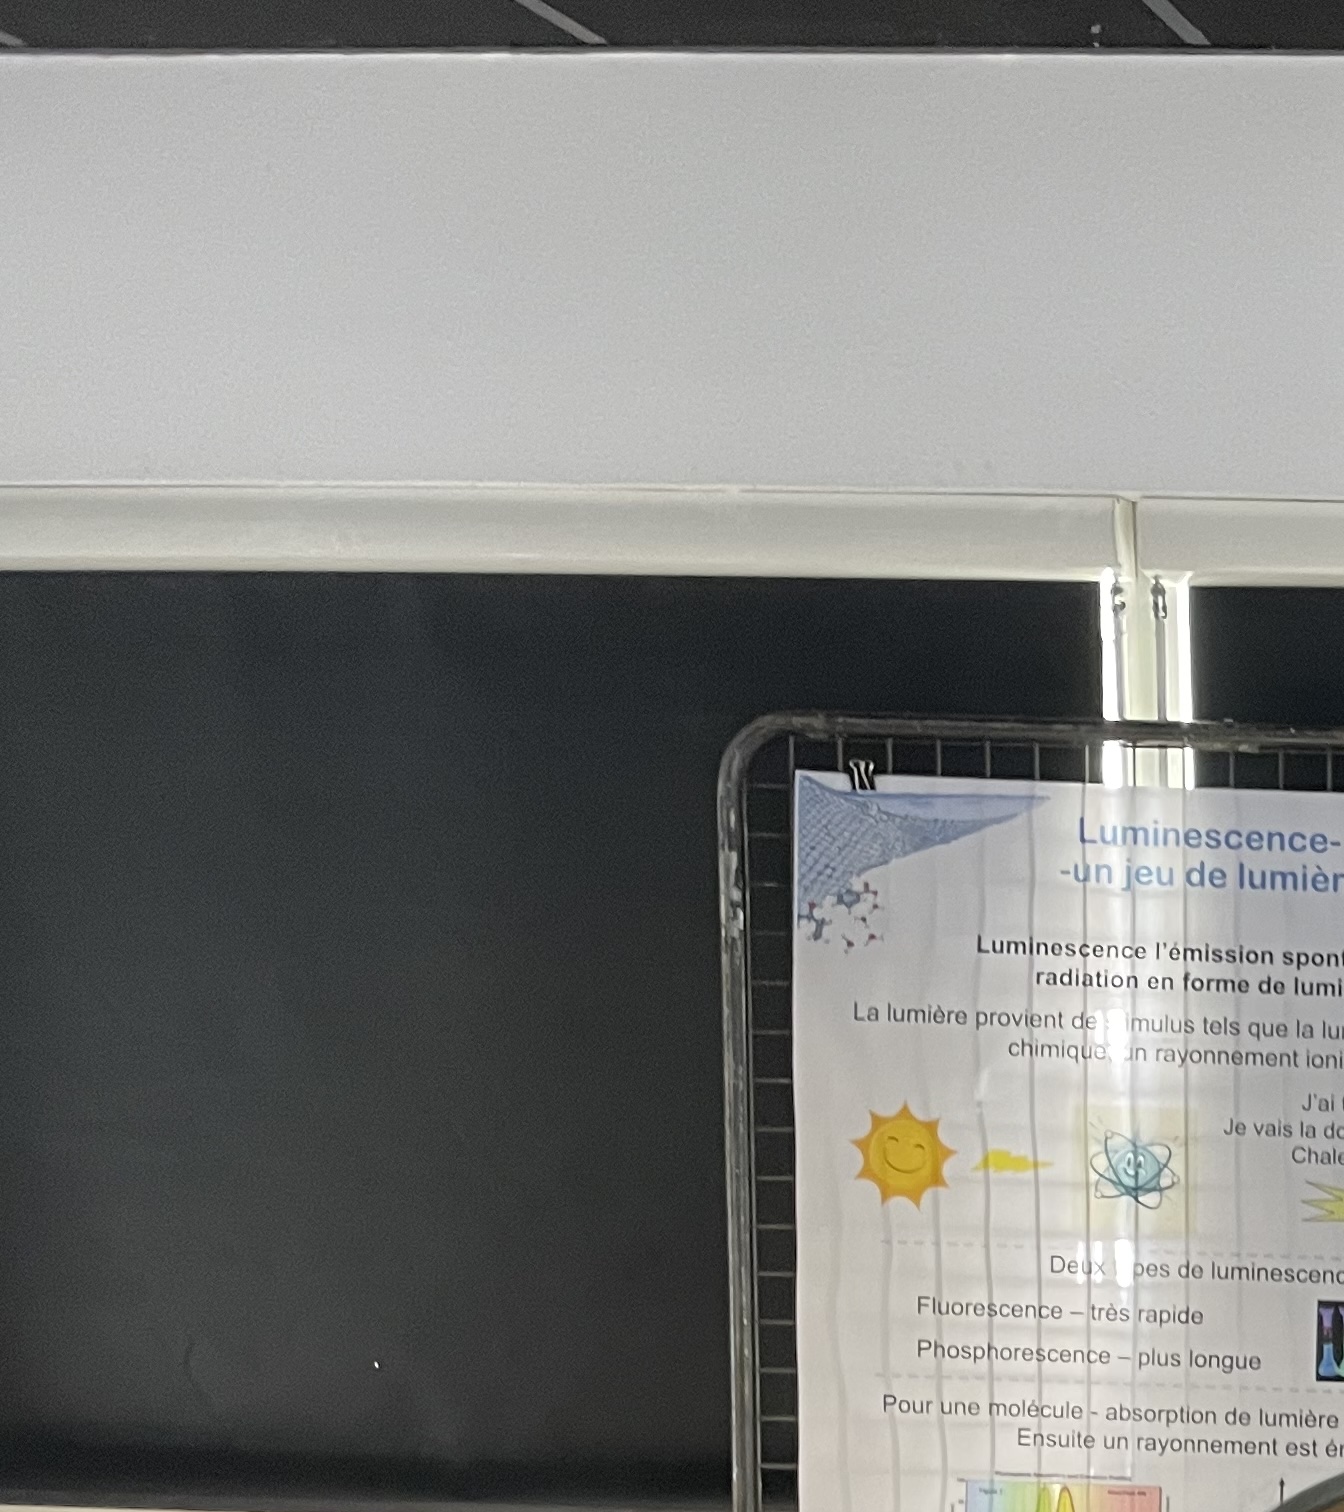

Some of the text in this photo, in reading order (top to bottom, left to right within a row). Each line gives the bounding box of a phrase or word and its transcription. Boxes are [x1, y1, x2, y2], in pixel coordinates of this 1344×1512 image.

[1079, 816, 1341, 853] Luminescence-
[1061, 862, 1112, 884] -un
[1122, 858, 1174, 891] jeu
[1185, 860, 1227, 888] de
[977, 934, 1147, 960] Luminescence
[1155, 942, 1274, 967] l'émission
[1035, 968, 1138, 989] radiation
[1147, 976, 1174, 991] en
[1183, 972, 1250, 994] forme
[1258, 976, 1285, 996] de
[853, 1001, 880, 1022] La
[887, 1003, 968, 1025] lumière
[975, 1010, 1064, 1030] provient
[1105, 1012, 1195, 1034] imulus
[1203, 1016, 1241, 1036] tels
[1248, 1021, 1288, 1041] que
[1296, 1019, 1314, 1039] la
[1155, 1047, 1299, 1070] rayonnement
[1302, 1093, 1334, 1112] J'ai
[1224, 1118, 1246, 1137] Je
[1253, 1120, 1292, 1138] vais
[1300, 1121, 1316, 1139] la
[1050, 1255, 1106, 1275] Deux
[1115, 1258, 1171, 1280] pes
[1177, 1259, 1204, 1280] de
[917, 1296, 1204, 1327] Fluorescence très rapide
[917, 1340, 1261, 1374] Phosphorescence plus longue
[883, 1394, 933, 1414] Pour
[940, 1401, 980, 1416] une
[988, 1400, 1083, 1419] molécule
[1105, 1404, 1217, 1427] absorption
[1225, 1407, 1250, 1426] de
[1259, 1408, 1338, 1428] lumière
[1018, 1428, 1096, 1449] Ensuite
[1103, 1435, 1129, 1450] un
[1137, 1437, 1277, 1457] rayonnement
[1285, 1440, 1318, 1457] est
